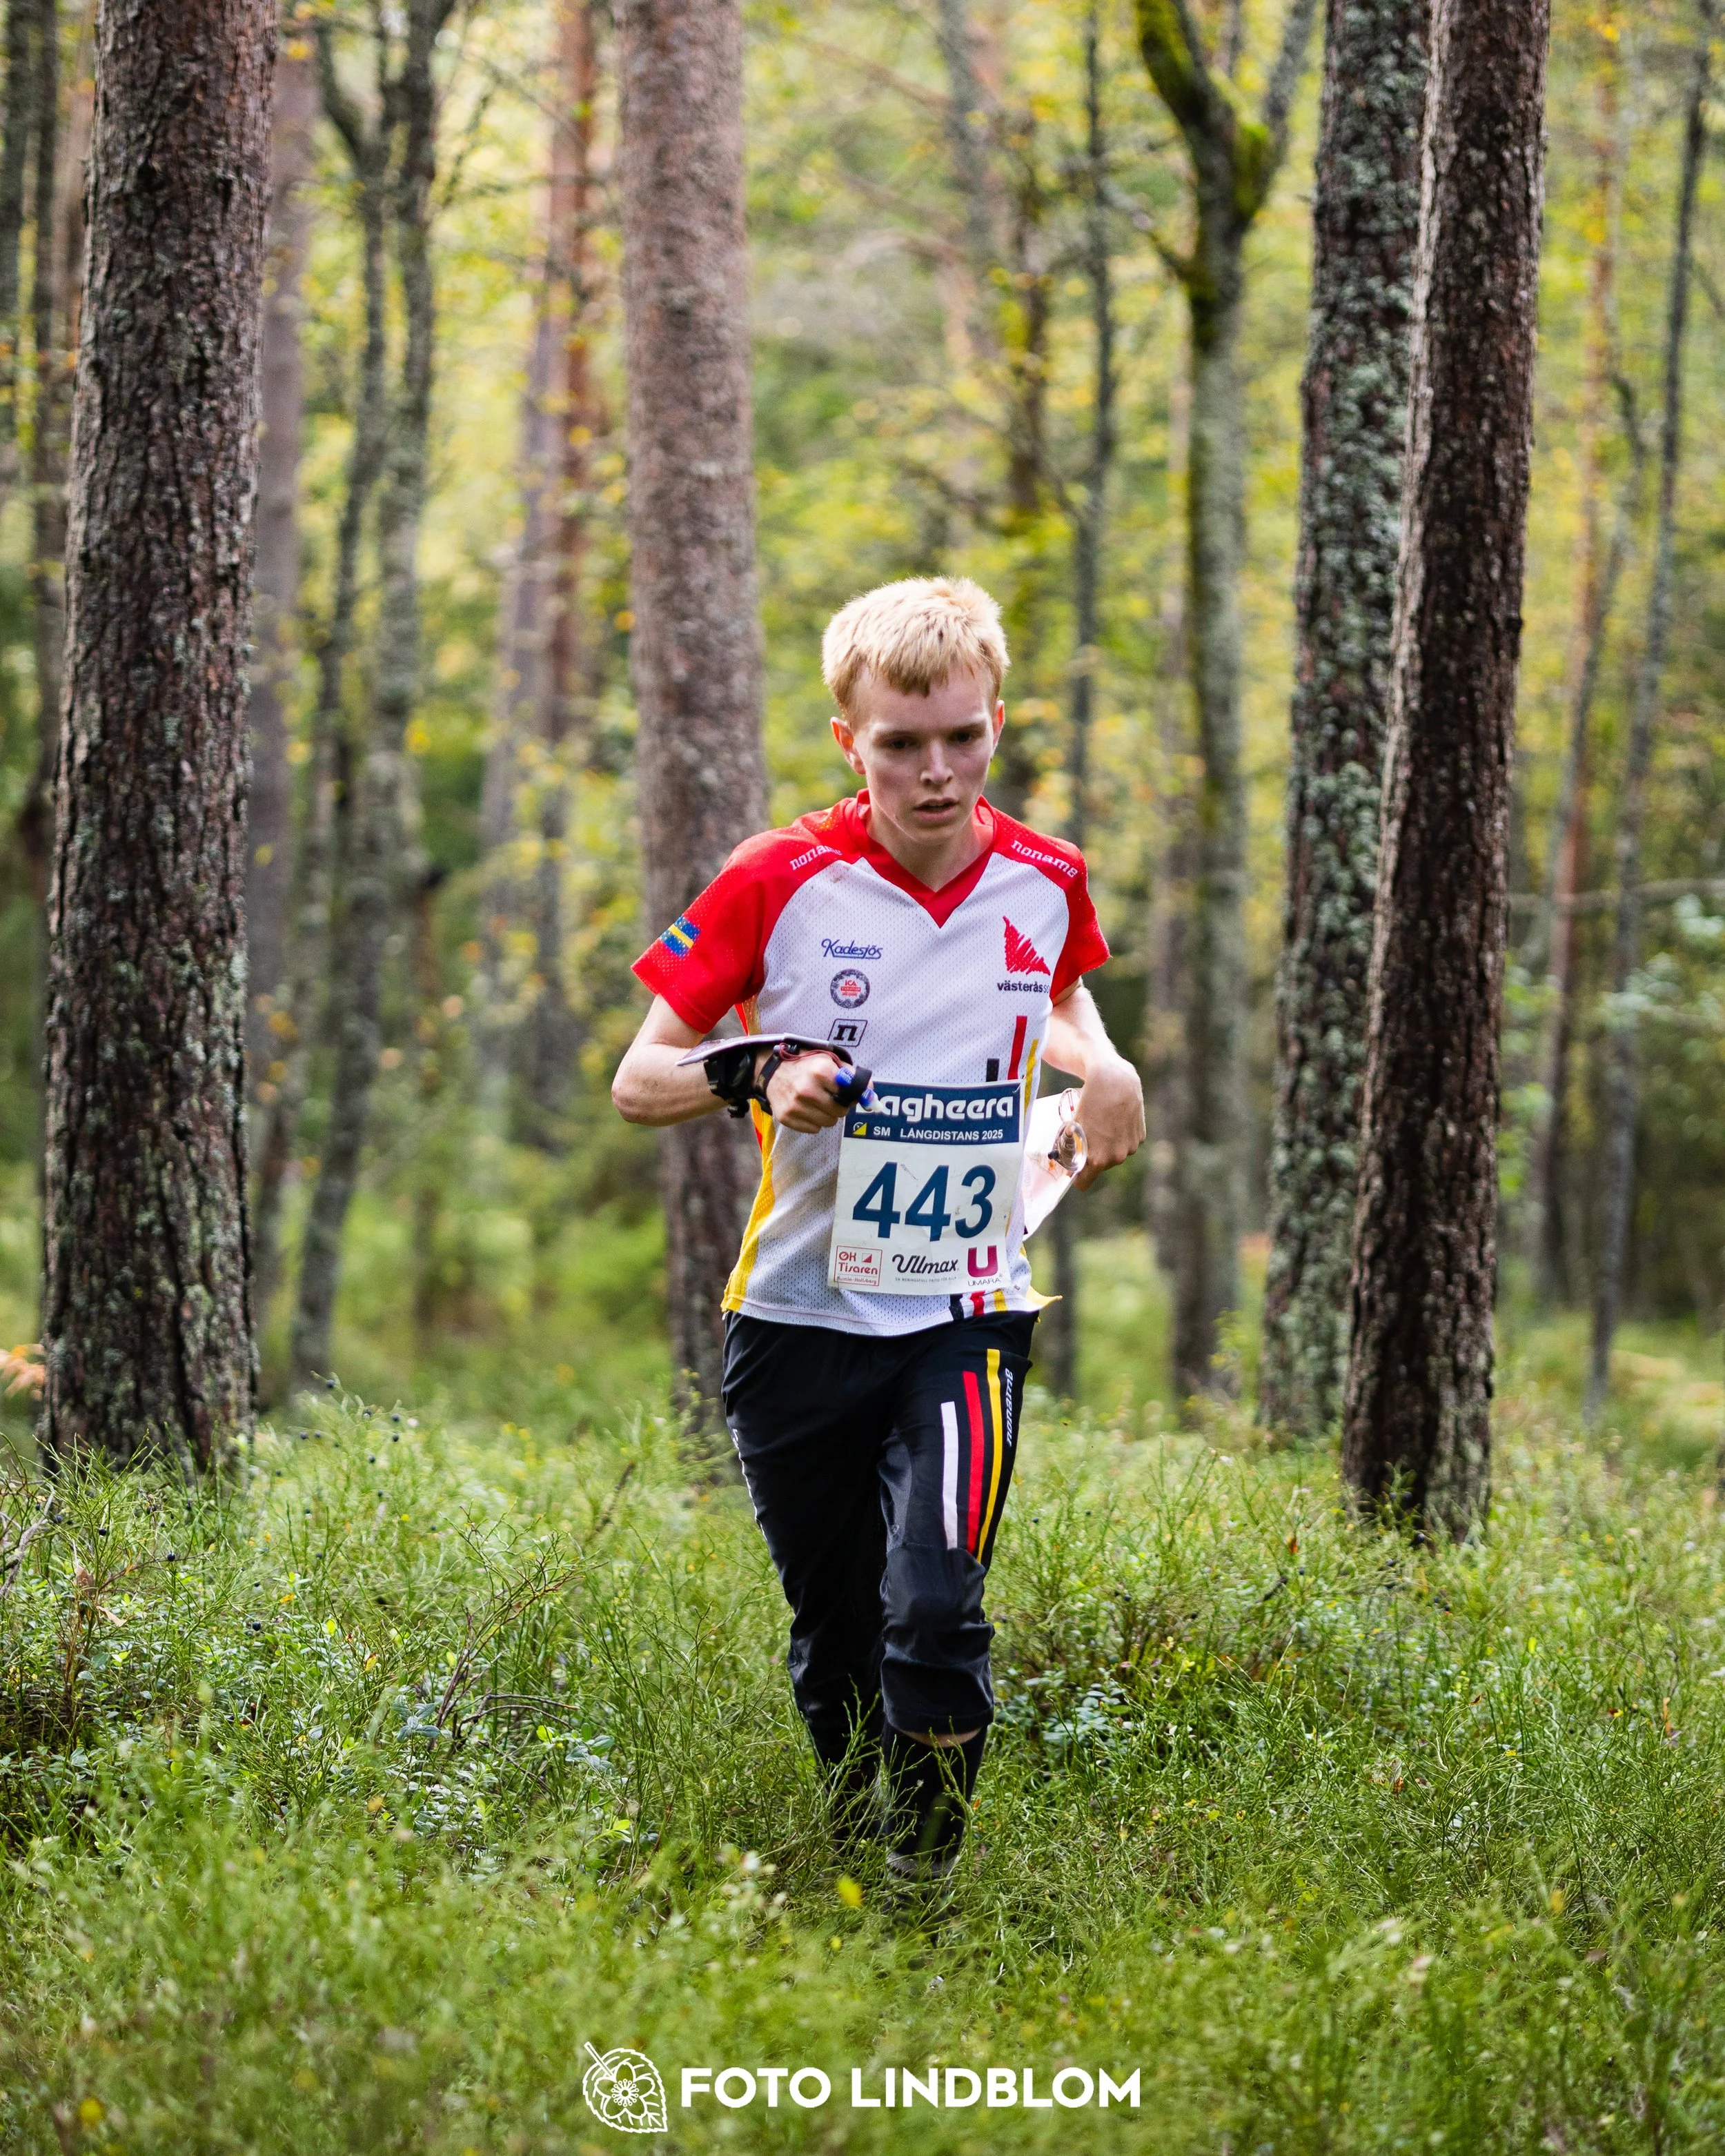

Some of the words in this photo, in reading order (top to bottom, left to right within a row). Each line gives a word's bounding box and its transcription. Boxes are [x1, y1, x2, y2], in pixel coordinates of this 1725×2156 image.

[1011, 840, 1078, 878] noname
[821, 938, 883, 960] Kadesjös
[856, 1094, 1014, 1122] agheera
[874, 1126, 891, 1137] SM
[900, 1127, 979, 1140] LÅNGDISTANS
[982, 1129, 1003, 1140] 2025
[852, 1161, 996, 1242] 443
[838, 1262, 878, 1275] Tisaren
[891, 1254, 958, 1274] Ullmax
[967, 1278, 1001, 1287] UMARA
